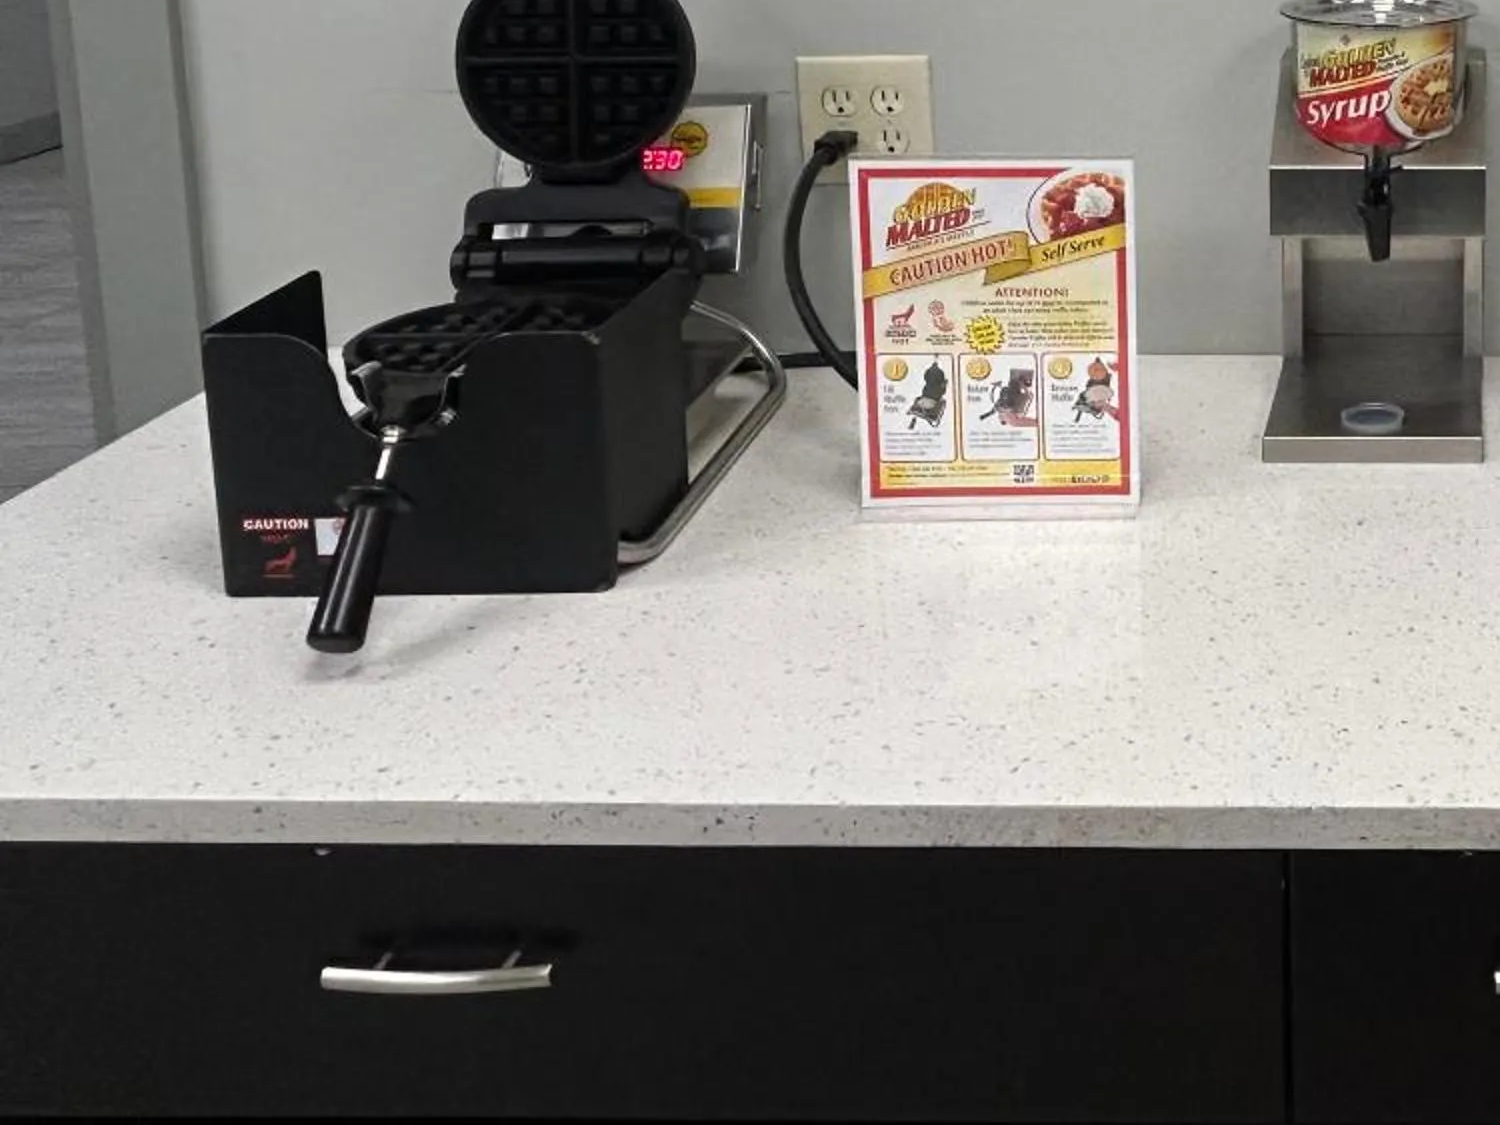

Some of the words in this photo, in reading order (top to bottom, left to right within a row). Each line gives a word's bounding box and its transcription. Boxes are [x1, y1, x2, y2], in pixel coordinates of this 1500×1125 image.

[1306, 89, 1392, 128] Syrup
[886, 207, 971, 247] MALTED
[889, 251, 968, 286] CAUTION
[971, 237, 1016, 265] HOT!
[1041, 244, 1067, 262] Self
[1071, 235, 1106, 253] Serve
[994, 286, 1070, 298] ATTENTION!
[243, 518, 309, 530] CAUTION
